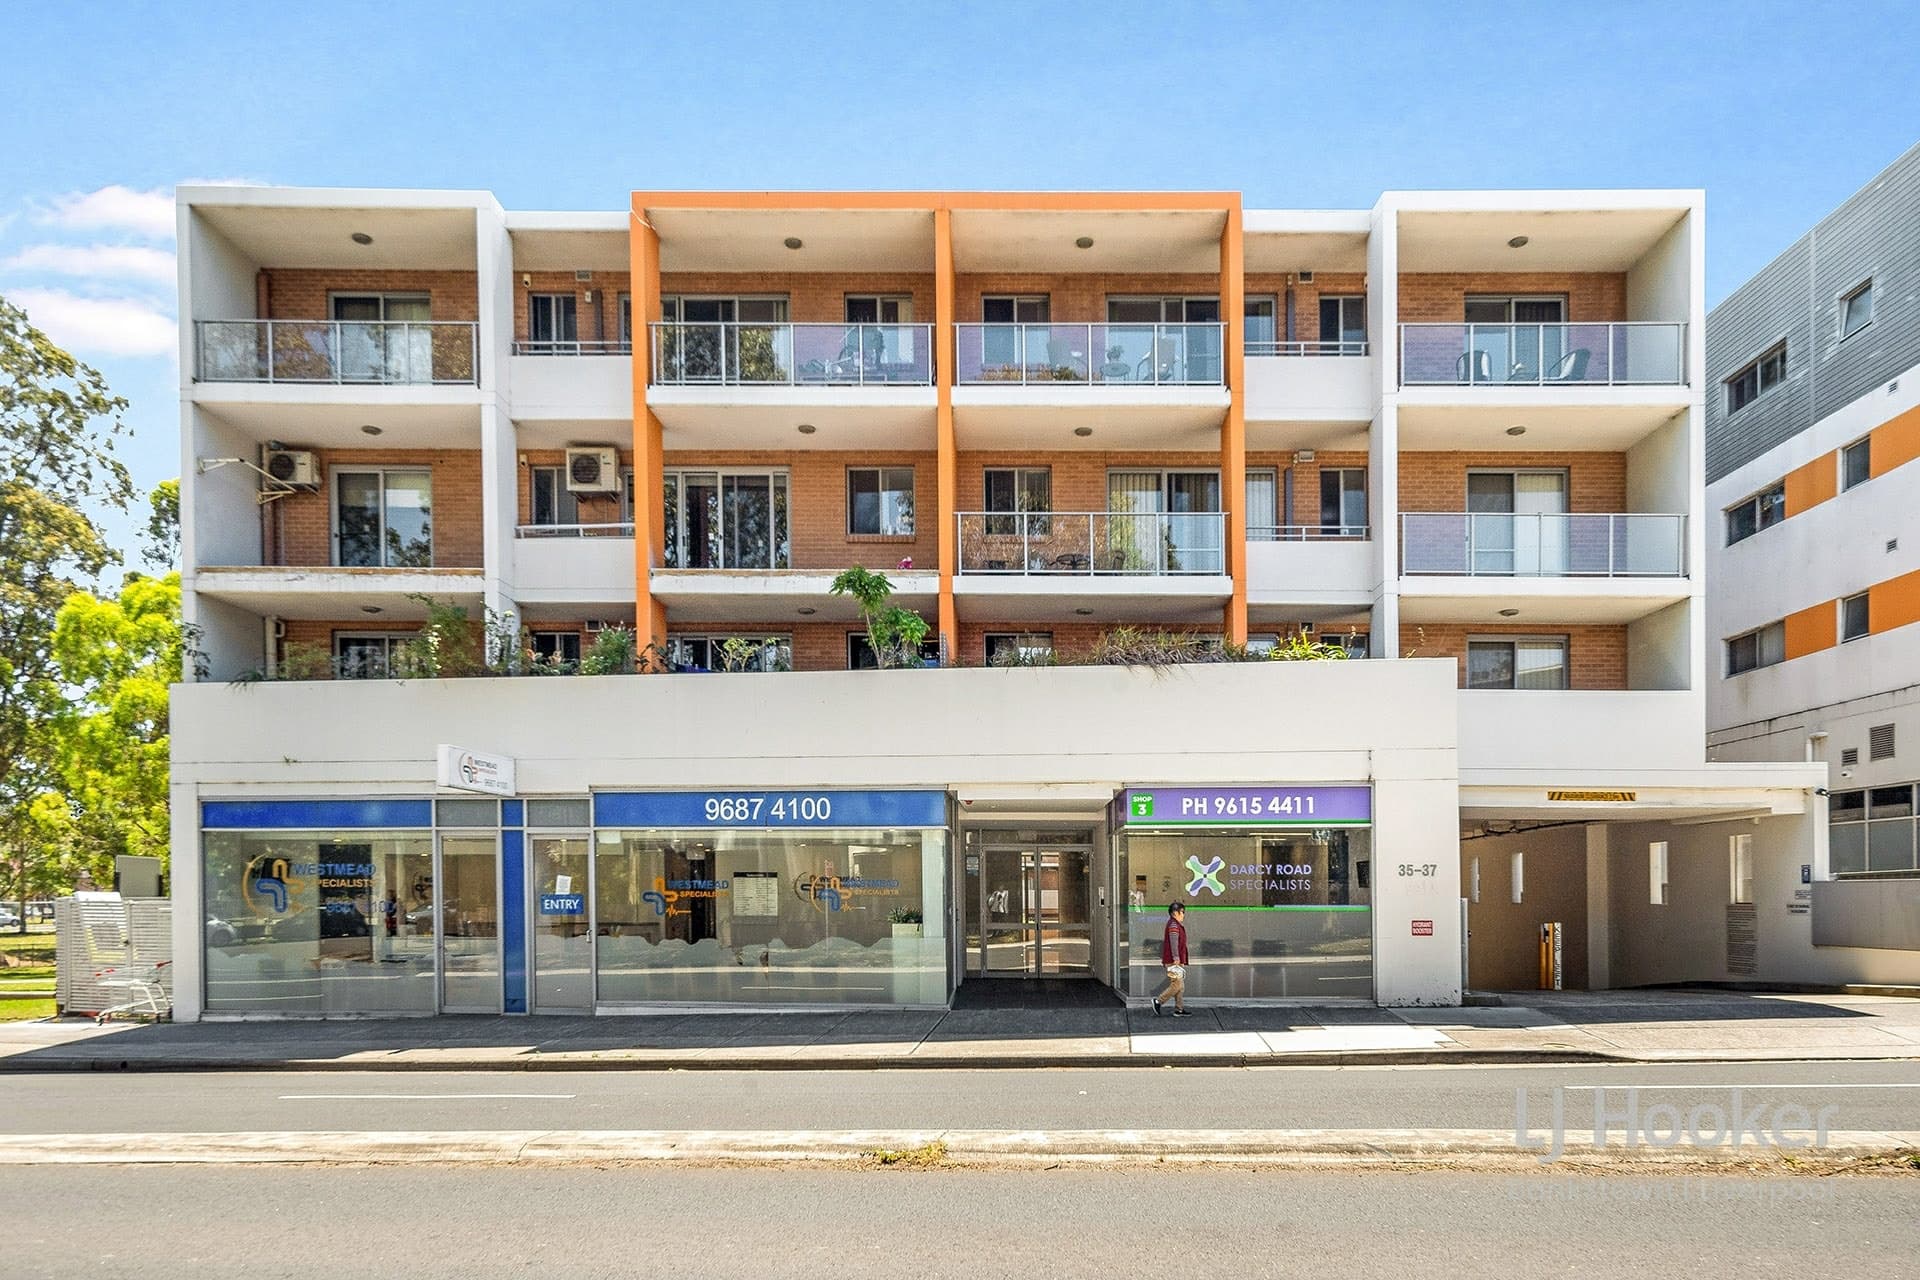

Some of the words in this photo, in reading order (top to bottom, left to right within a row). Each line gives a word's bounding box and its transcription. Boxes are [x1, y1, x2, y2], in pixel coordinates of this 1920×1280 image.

[705, 798, 764, 820] 9687
[770, 797, 831, 820] 4100
[1138, 803, 1147, 815] 3
[1182, 798, 1207, 815] PH
[1214, 797, 1262, 815] 9615
[1268, 796, 1315, 814] 4411
[293, 864, 376, 876] WESTMEAD
[1230, 864, 1272, 875] DARCY
[1276, 864, 1312, 875] ROAD
[1398, 864, 1437, 877] 35-37
[667, 880, 729, 889] WESTMEAD
[1230, 879, 1311, 890] SPECIALISTS
[544, 899, 580, 910] ENTRY
